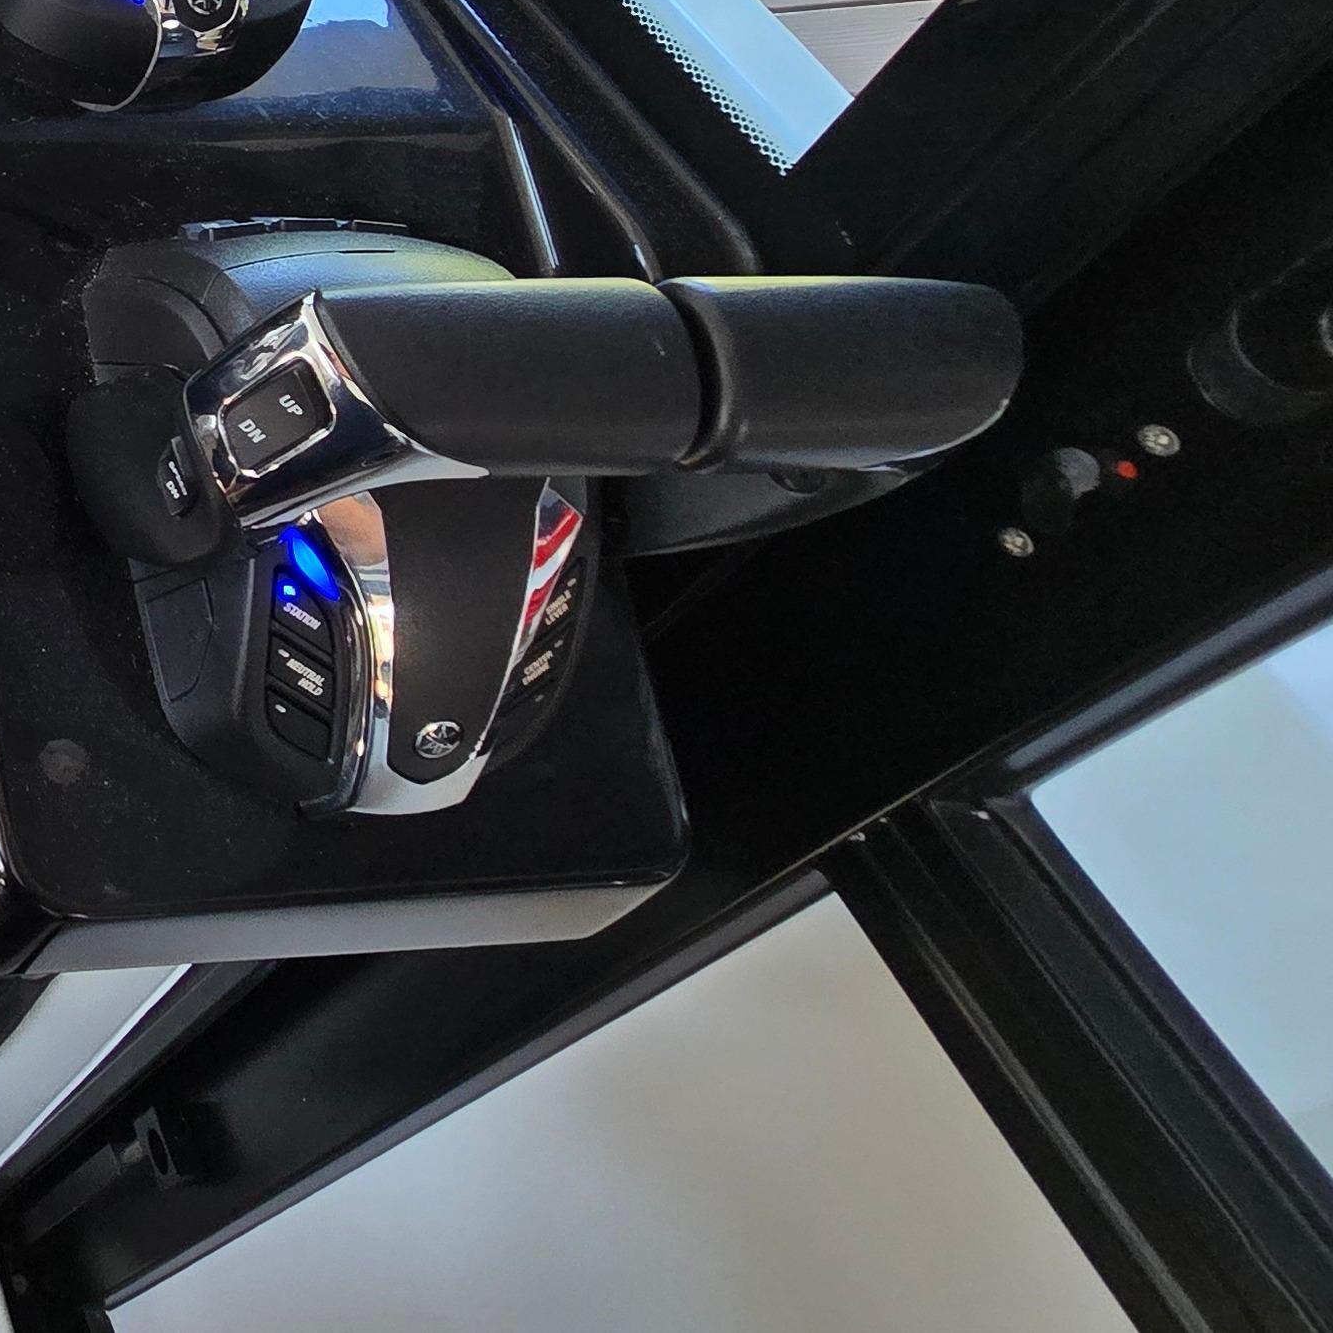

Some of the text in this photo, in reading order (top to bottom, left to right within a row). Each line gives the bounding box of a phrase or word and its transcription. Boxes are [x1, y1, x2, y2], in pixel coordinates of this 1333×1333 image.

[278, 394, 304, 416] UP
[237, 418, 267, 444] DN
[283, 601, 322, 631] STATION
[286, 658, 326, 687] NEUTRAL
[297, 677, 324, 697] HOLD
